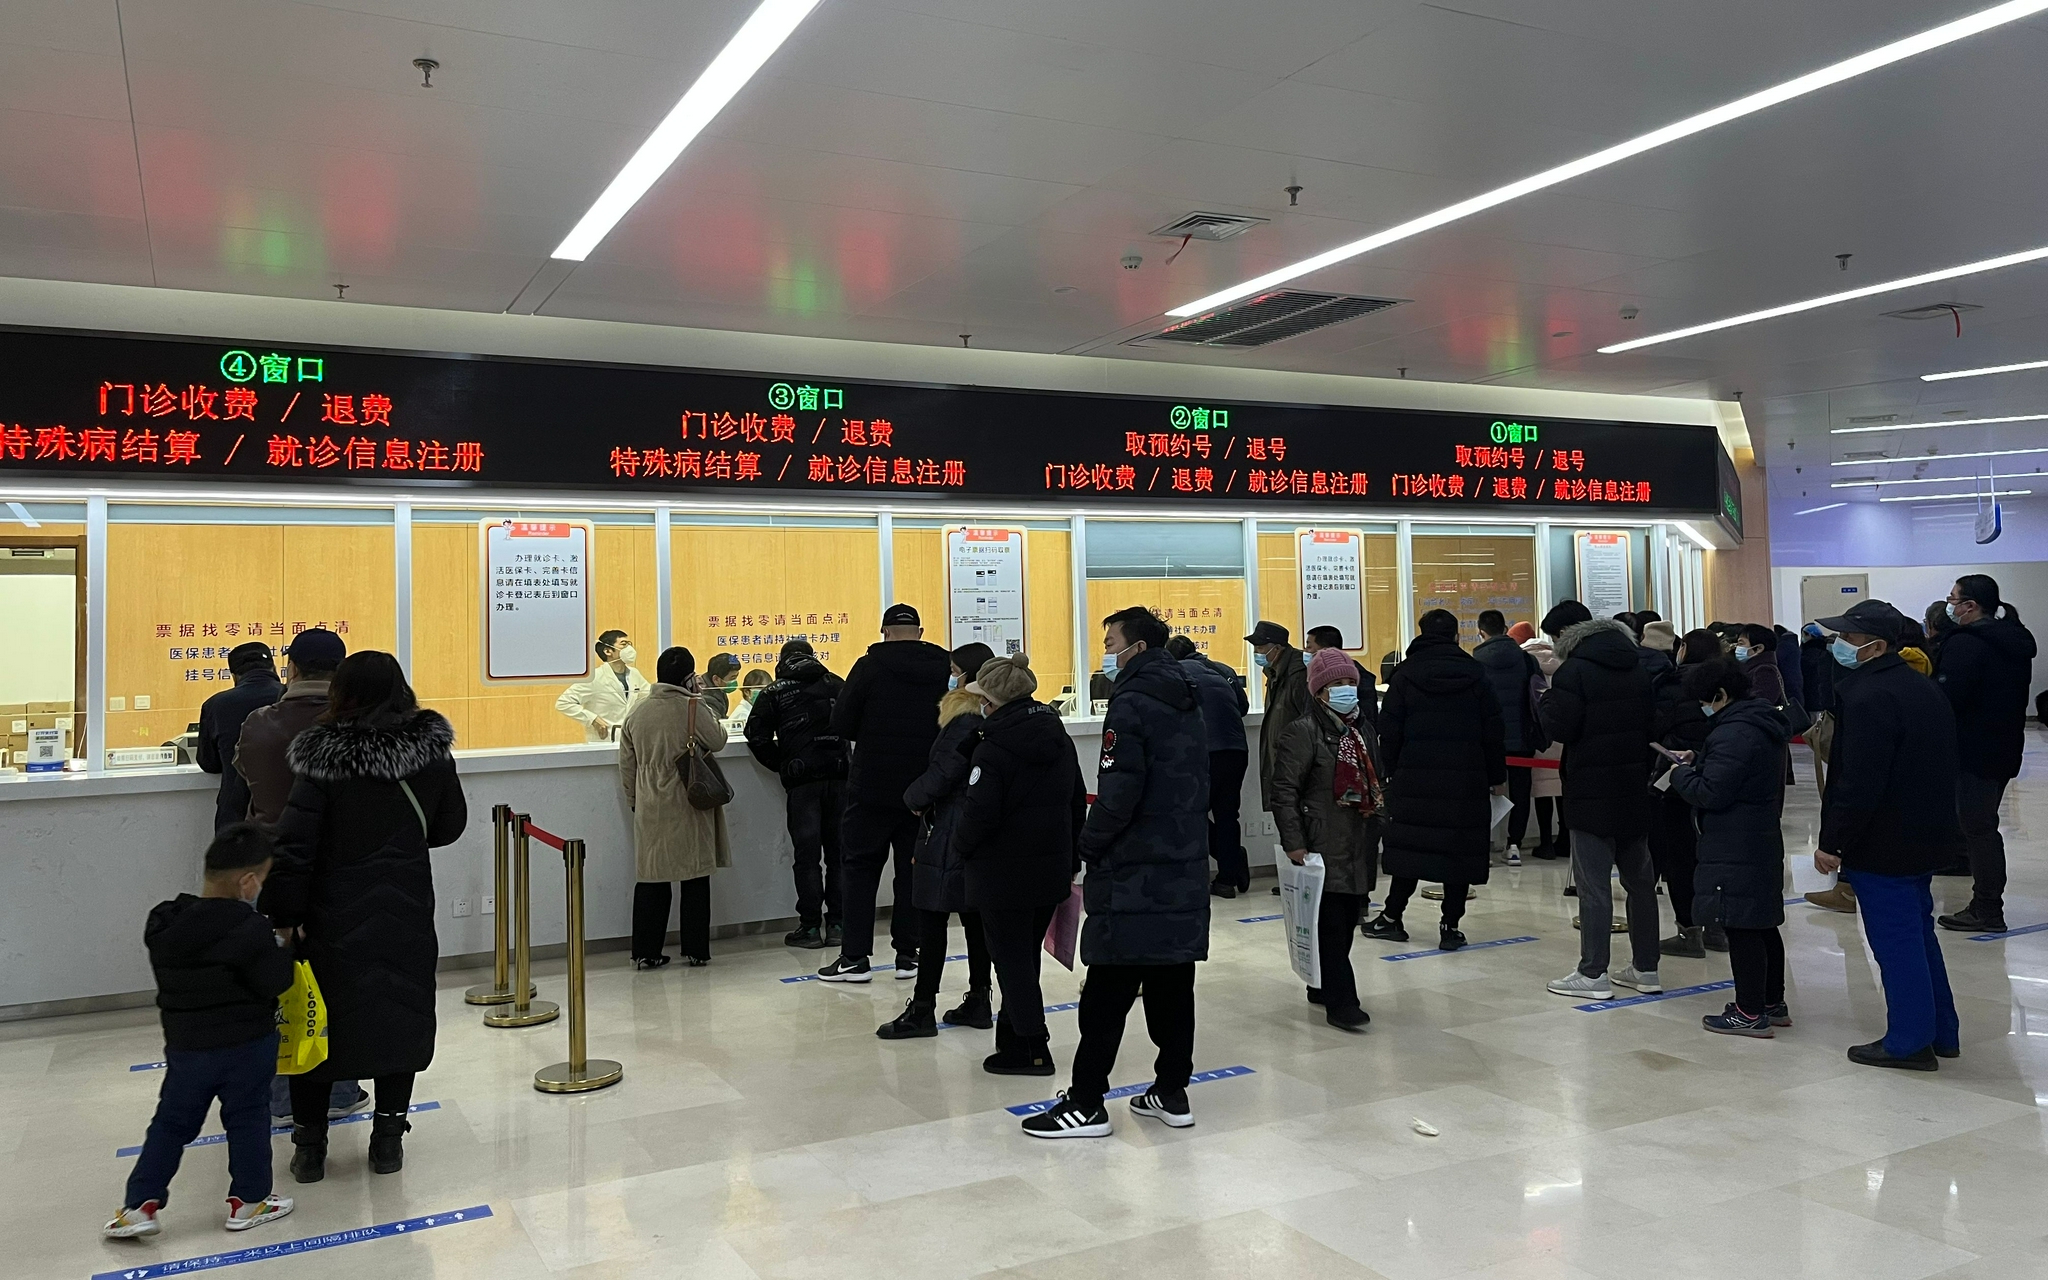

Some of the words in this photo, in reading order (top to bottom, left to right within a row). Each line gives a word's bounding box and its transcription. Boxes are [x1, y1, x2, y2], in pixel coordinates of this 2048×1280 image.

[100, 382, 258, 421] 门诊收费
[281, 392, 301, 423] /
[322, 394, 392, 426] 退费
[682, 410, 795, 443] 门诊收费
[812, 417, 826, 444] /
[842, 420, 893, 446] 退费
[0, 423, 201, 465] 特殊病结算
[224, 435, 245, 465] /
[267, 435, 484, 472] 就诊信息注册
[1126, 432, 1210, 458] 取预约号
[1225, 436, 1235, 459] /
[1248, 438, 1286, 461] 退号
[1456, 445, 1525, 469] 取预约号
[1536, 449, 1544, 469] /
[1553, 450, 1584, 471] 退号
[610, 446, 761, 481] 特殊病结算
[777, 455, 792, 481] /
[809, 455, 966, 486] 就诊信息注册
[1046, 464, 1135, 490] 门诊收费
[1148, 467, 1160, 491] /
[1173, 467, 1213, 492] 退费
[1227, 470, 1238, 492] /
[1249, 470, 1368, 494] 就诊信息注册
[1392, 474, 1464, 498] 门诊收费
[1474, 478, 1484, 498] /
[1494, 477, 1527, 499] 退费
[1554, 479, 1651, 502] 就诊信息注册
[495, 566, 578, 575] 活医保卡、完善卡信
[515, 554, 579, 563] 办理就诊卡、激
[495, 578, 579, 587] 息请在填表处填写就
[496, 590, 578, 599] 诊卡登记表后到窗口
[496, 603, 520, 612] 办理。
[708, 613, 849, 628] 票据找零请当面点清
[155, 620, 350, 638] 票据找零请当面点清
[161, 1226, 381, 1272] 请保持一米以上间隔排队
